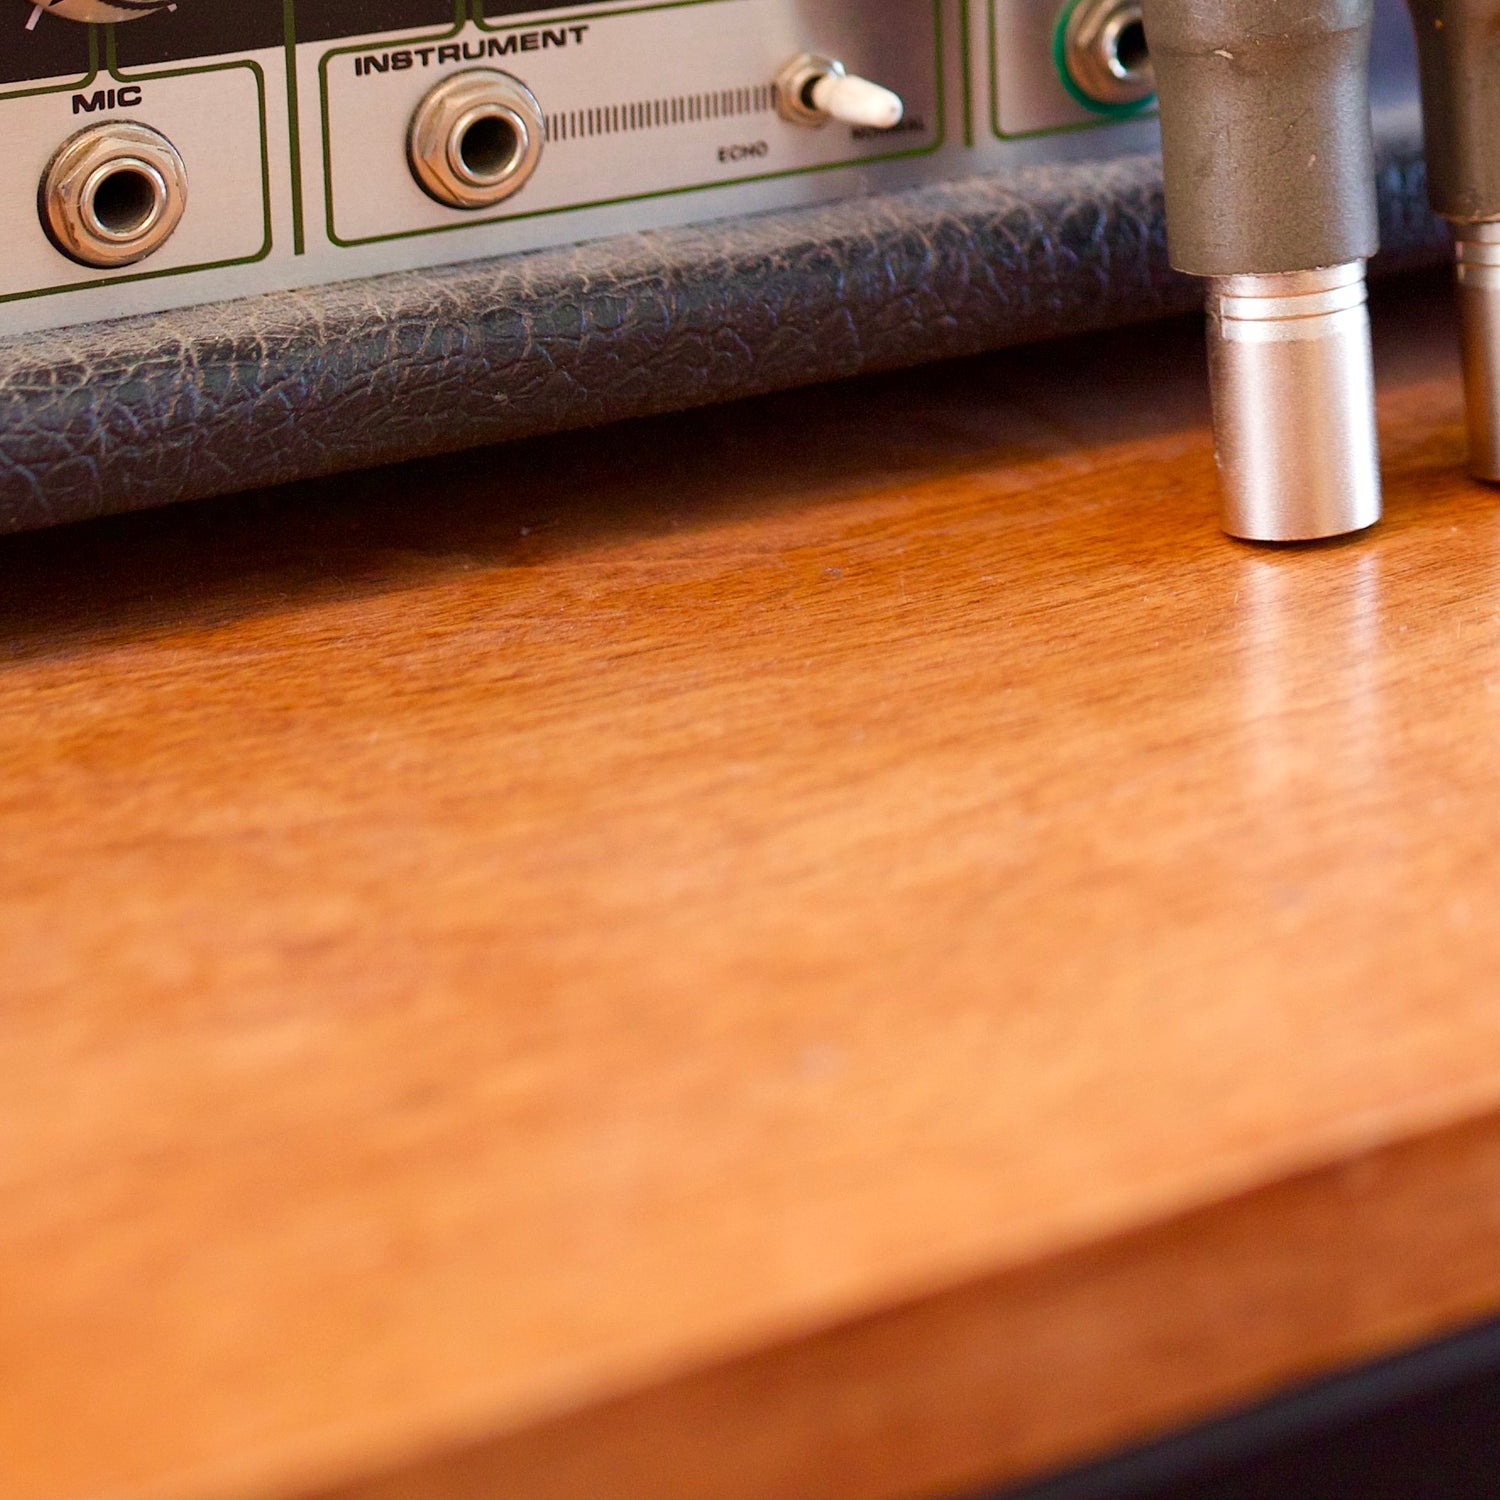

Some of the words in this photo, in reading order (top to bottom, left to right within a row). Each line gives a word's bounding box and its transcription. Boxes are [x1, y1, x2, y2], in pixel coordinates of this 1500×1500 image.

[354, 25, 589, 77] INSTRUMENT
[71, 85, 143, 115] MIC
[717, 140, 769, 164] ECHO
